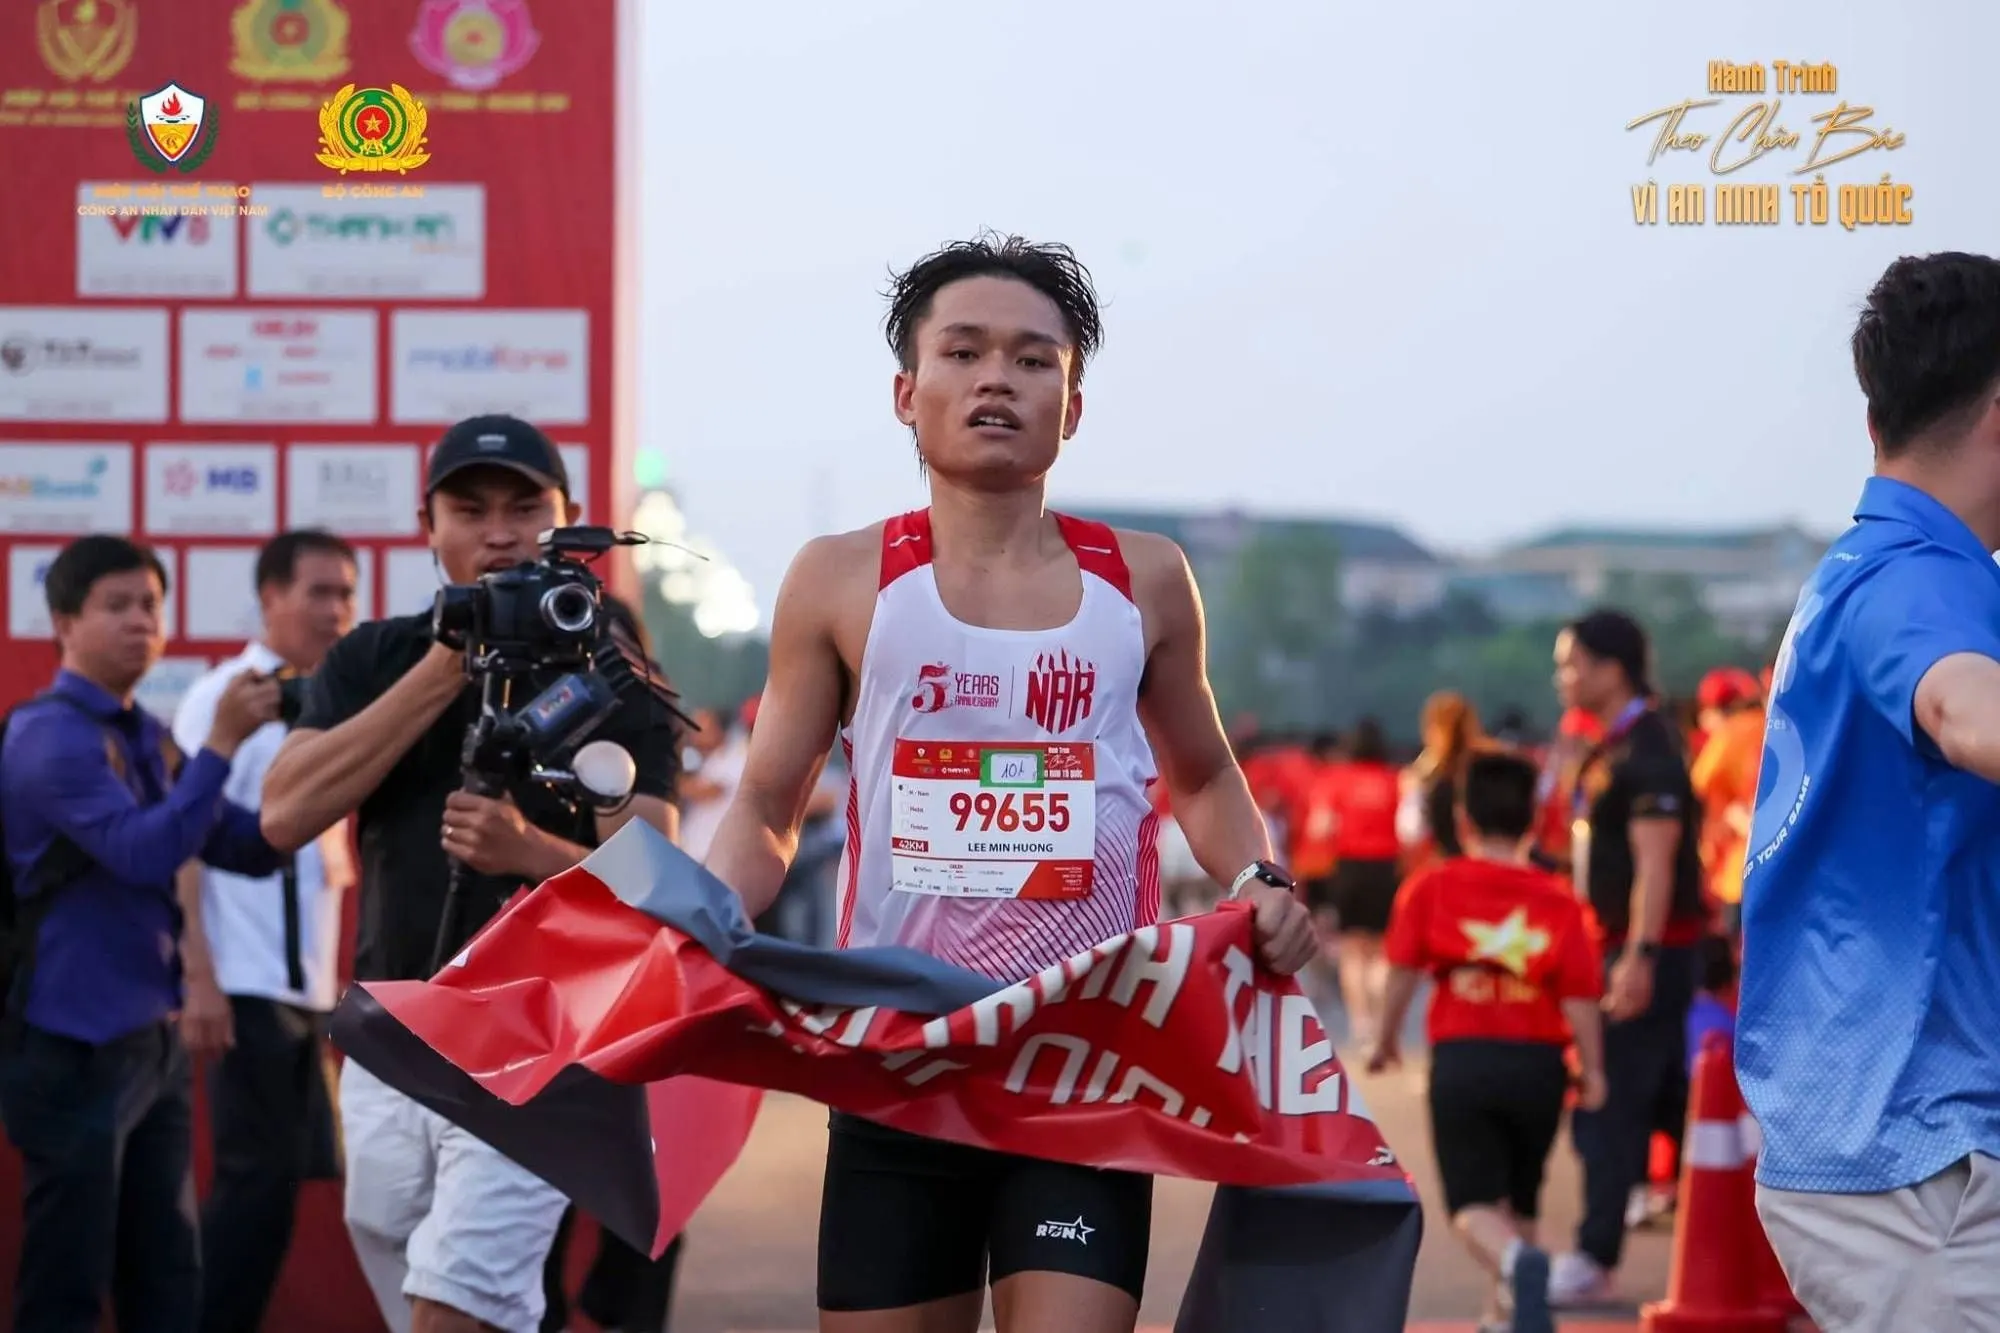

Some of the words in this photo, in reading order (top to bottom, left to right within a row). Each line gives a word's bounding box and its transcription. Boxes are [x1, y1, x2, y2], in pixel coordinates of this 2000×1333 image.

[954, 672, 999, 696] YEARS
[949, 791, 1071, 833] 99655
[1756, 827, 1788, 865] YOUR
[1788, 774, 1811, 826] GAME
[898, 840, 926, 852] 42KM
[968, 842, 987, 853] LEE
[989, 842, 1011, 854] MIN
[1013, 842, 1054, 854] HUONG
